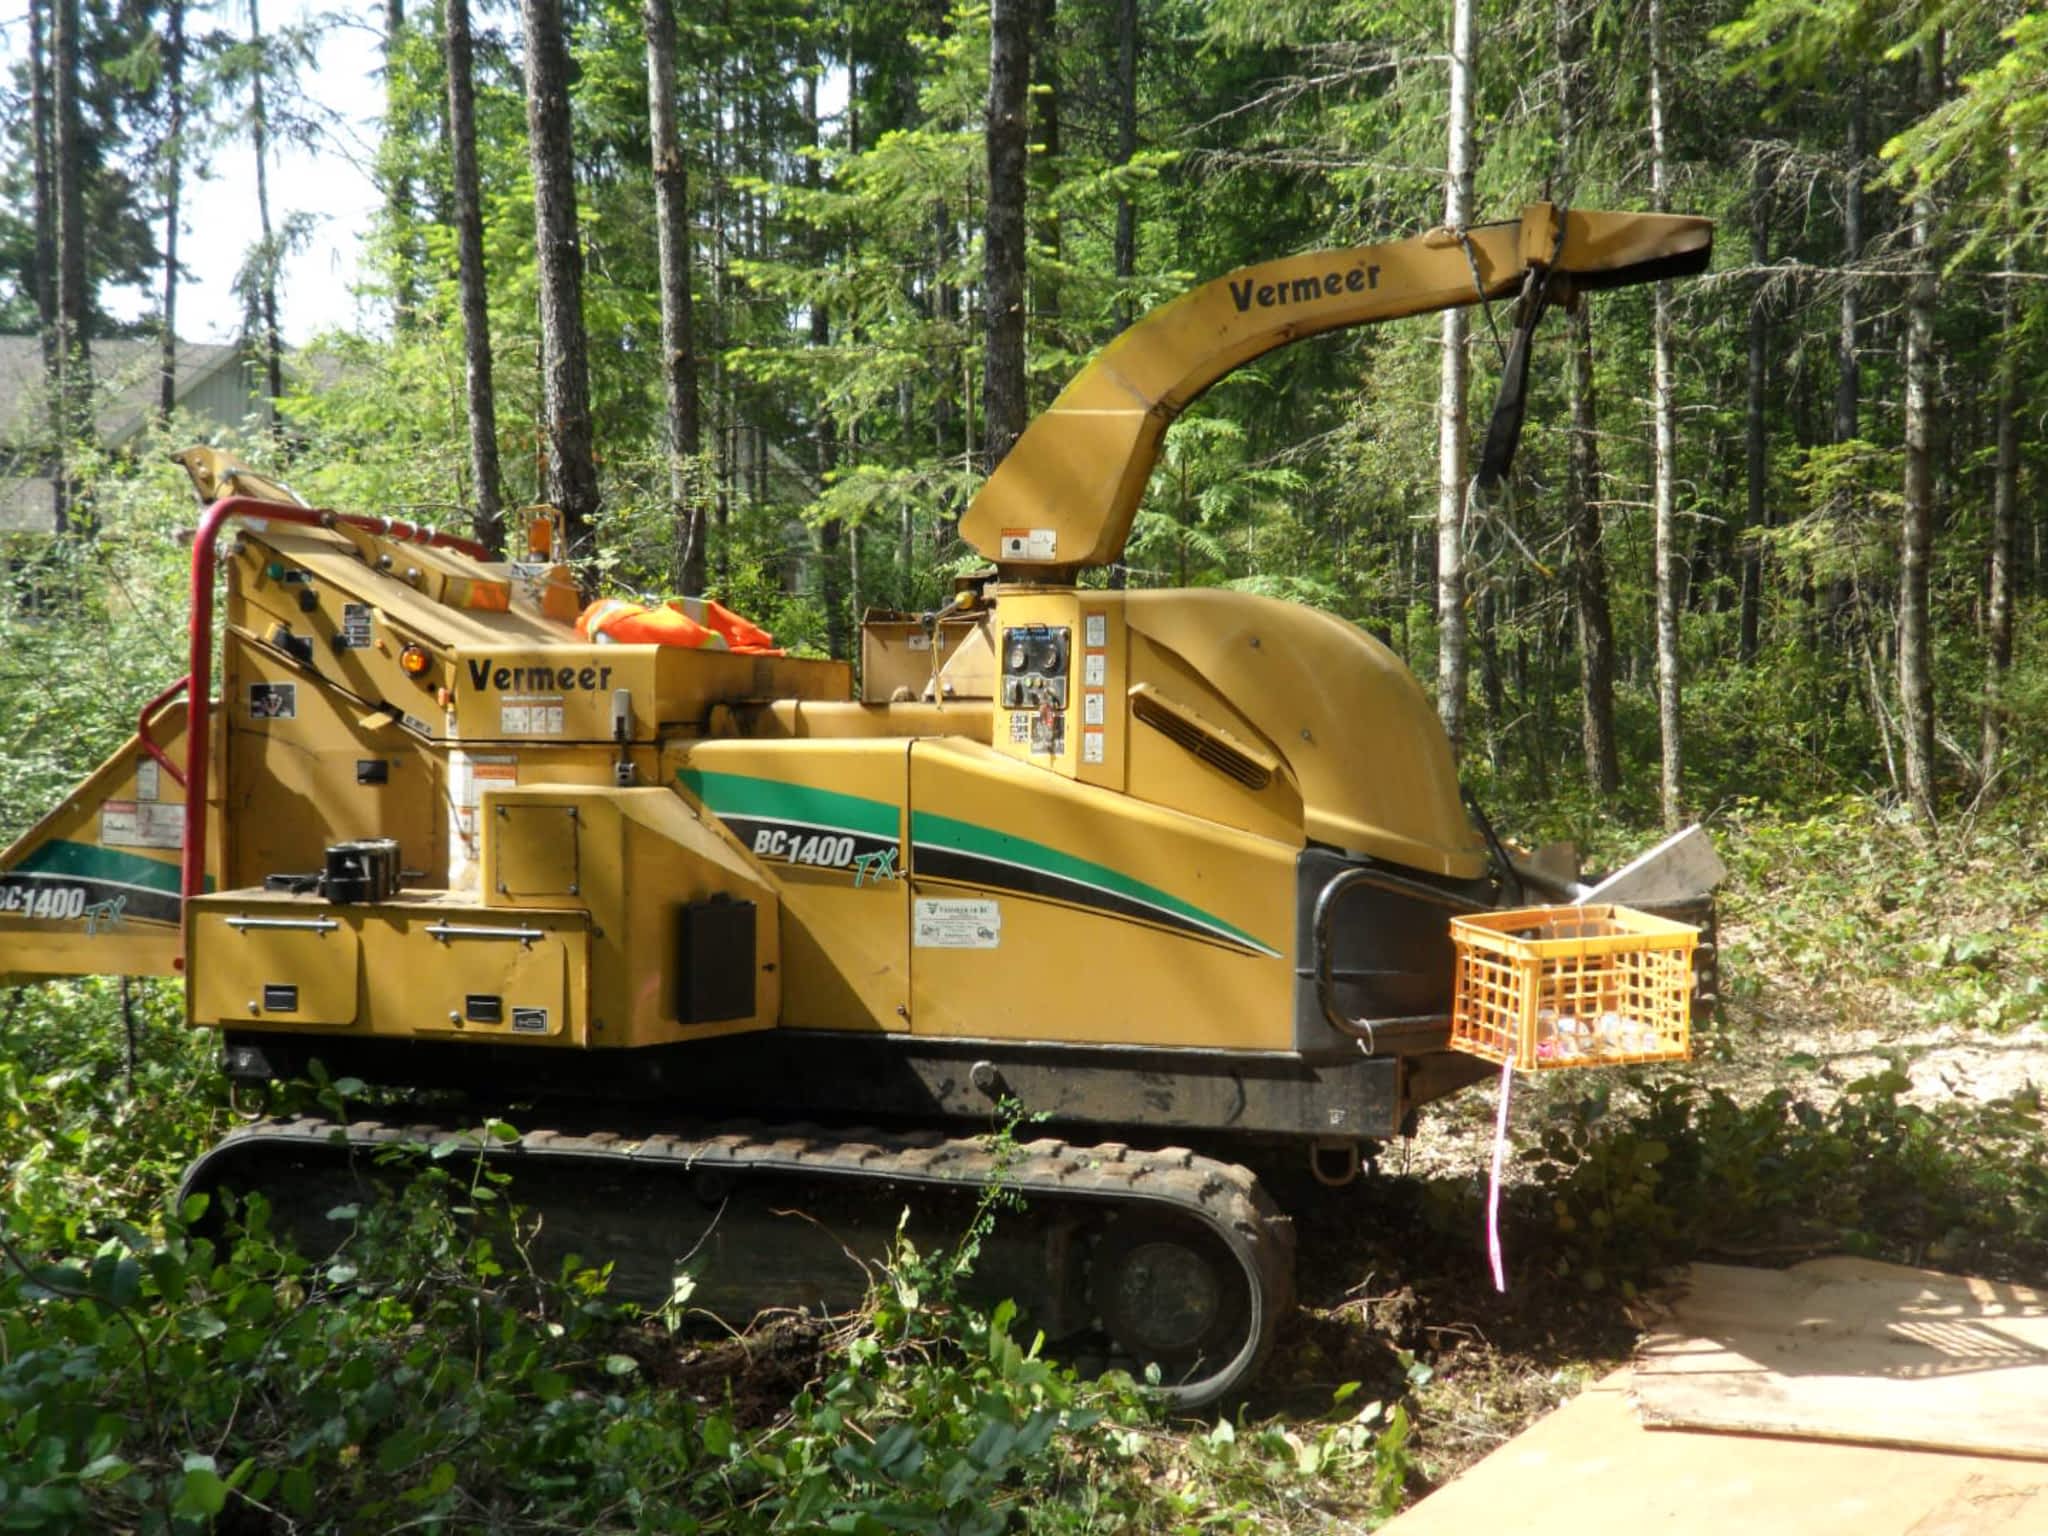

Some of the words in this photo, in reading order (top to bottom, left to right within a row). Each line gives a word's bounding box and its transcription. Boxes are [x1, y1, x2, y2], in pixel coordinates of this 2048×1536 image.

[1229, 264, 1381, 313] Vermeer
[467, 658, 613, 692] Vermeer
[854, 847, 898, 888] TX
